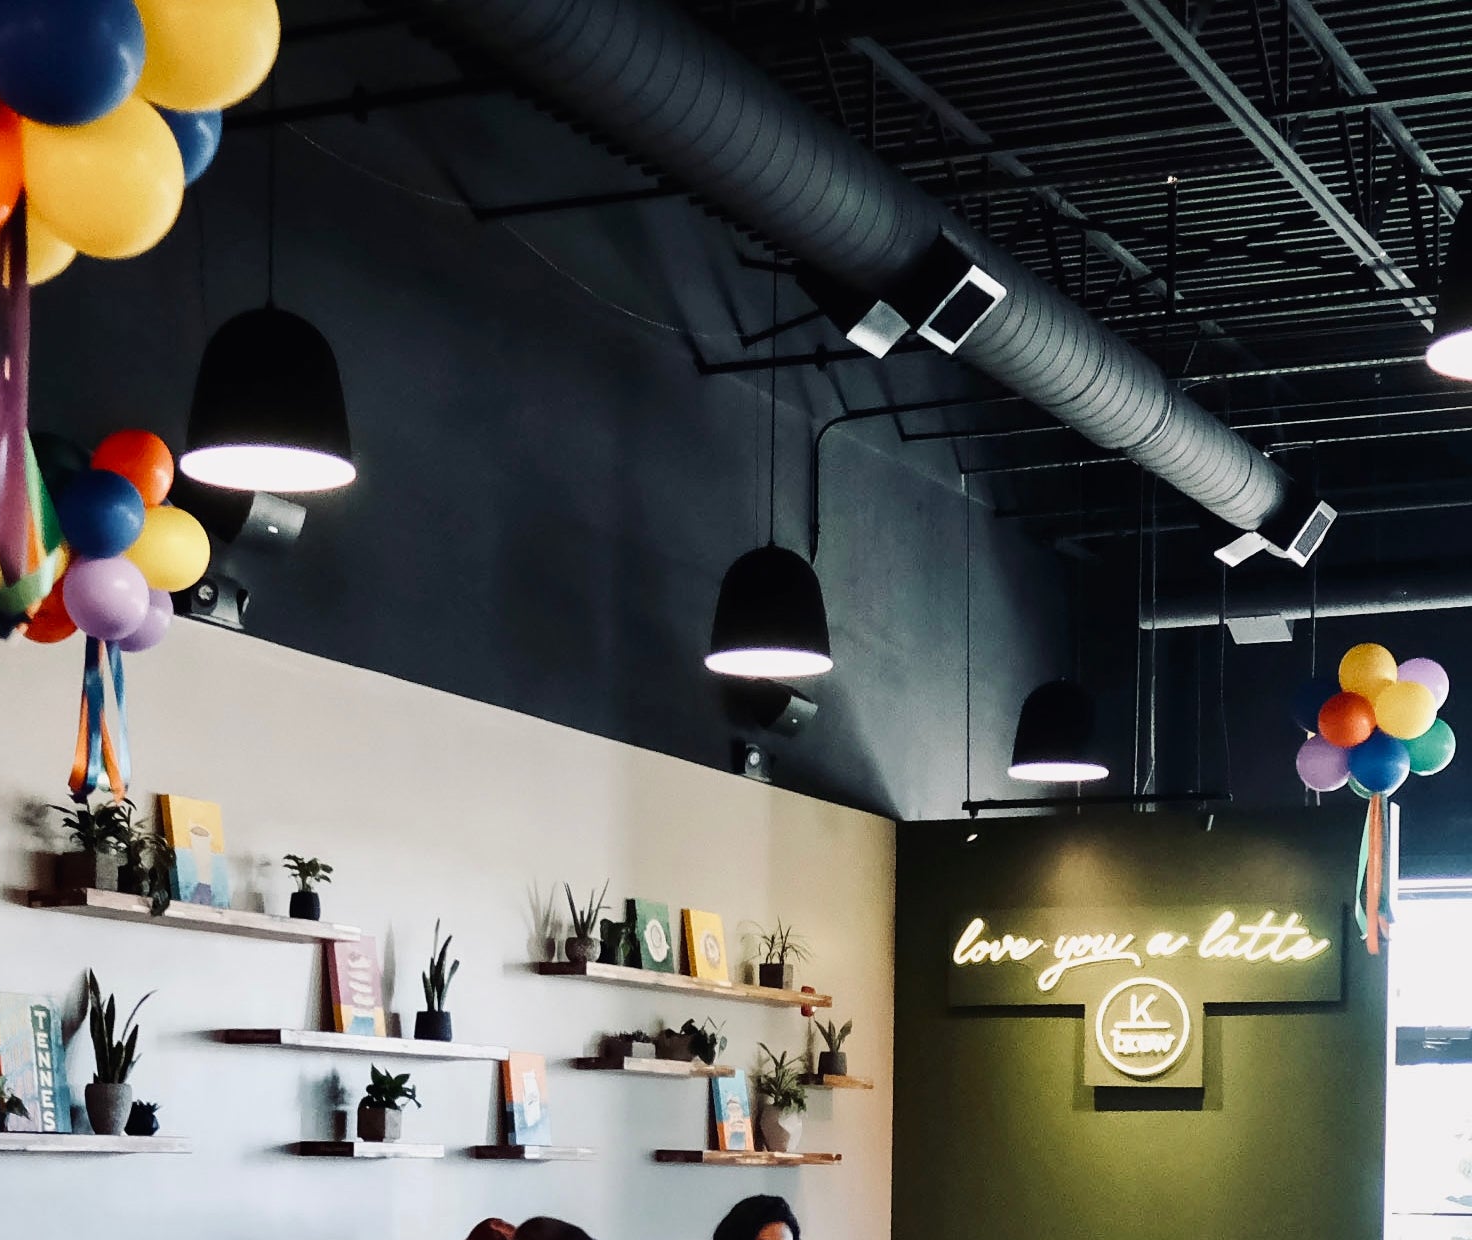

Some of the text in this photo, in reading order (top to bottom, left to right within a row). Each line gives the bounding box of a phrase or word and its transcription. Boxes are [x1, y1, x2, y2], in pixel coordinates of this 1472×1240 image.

[953, 910, 1329, 991] love you a latte
[1129, 993, 1158, 1024] K
[33, 1009, 57, 1132] TENNES
